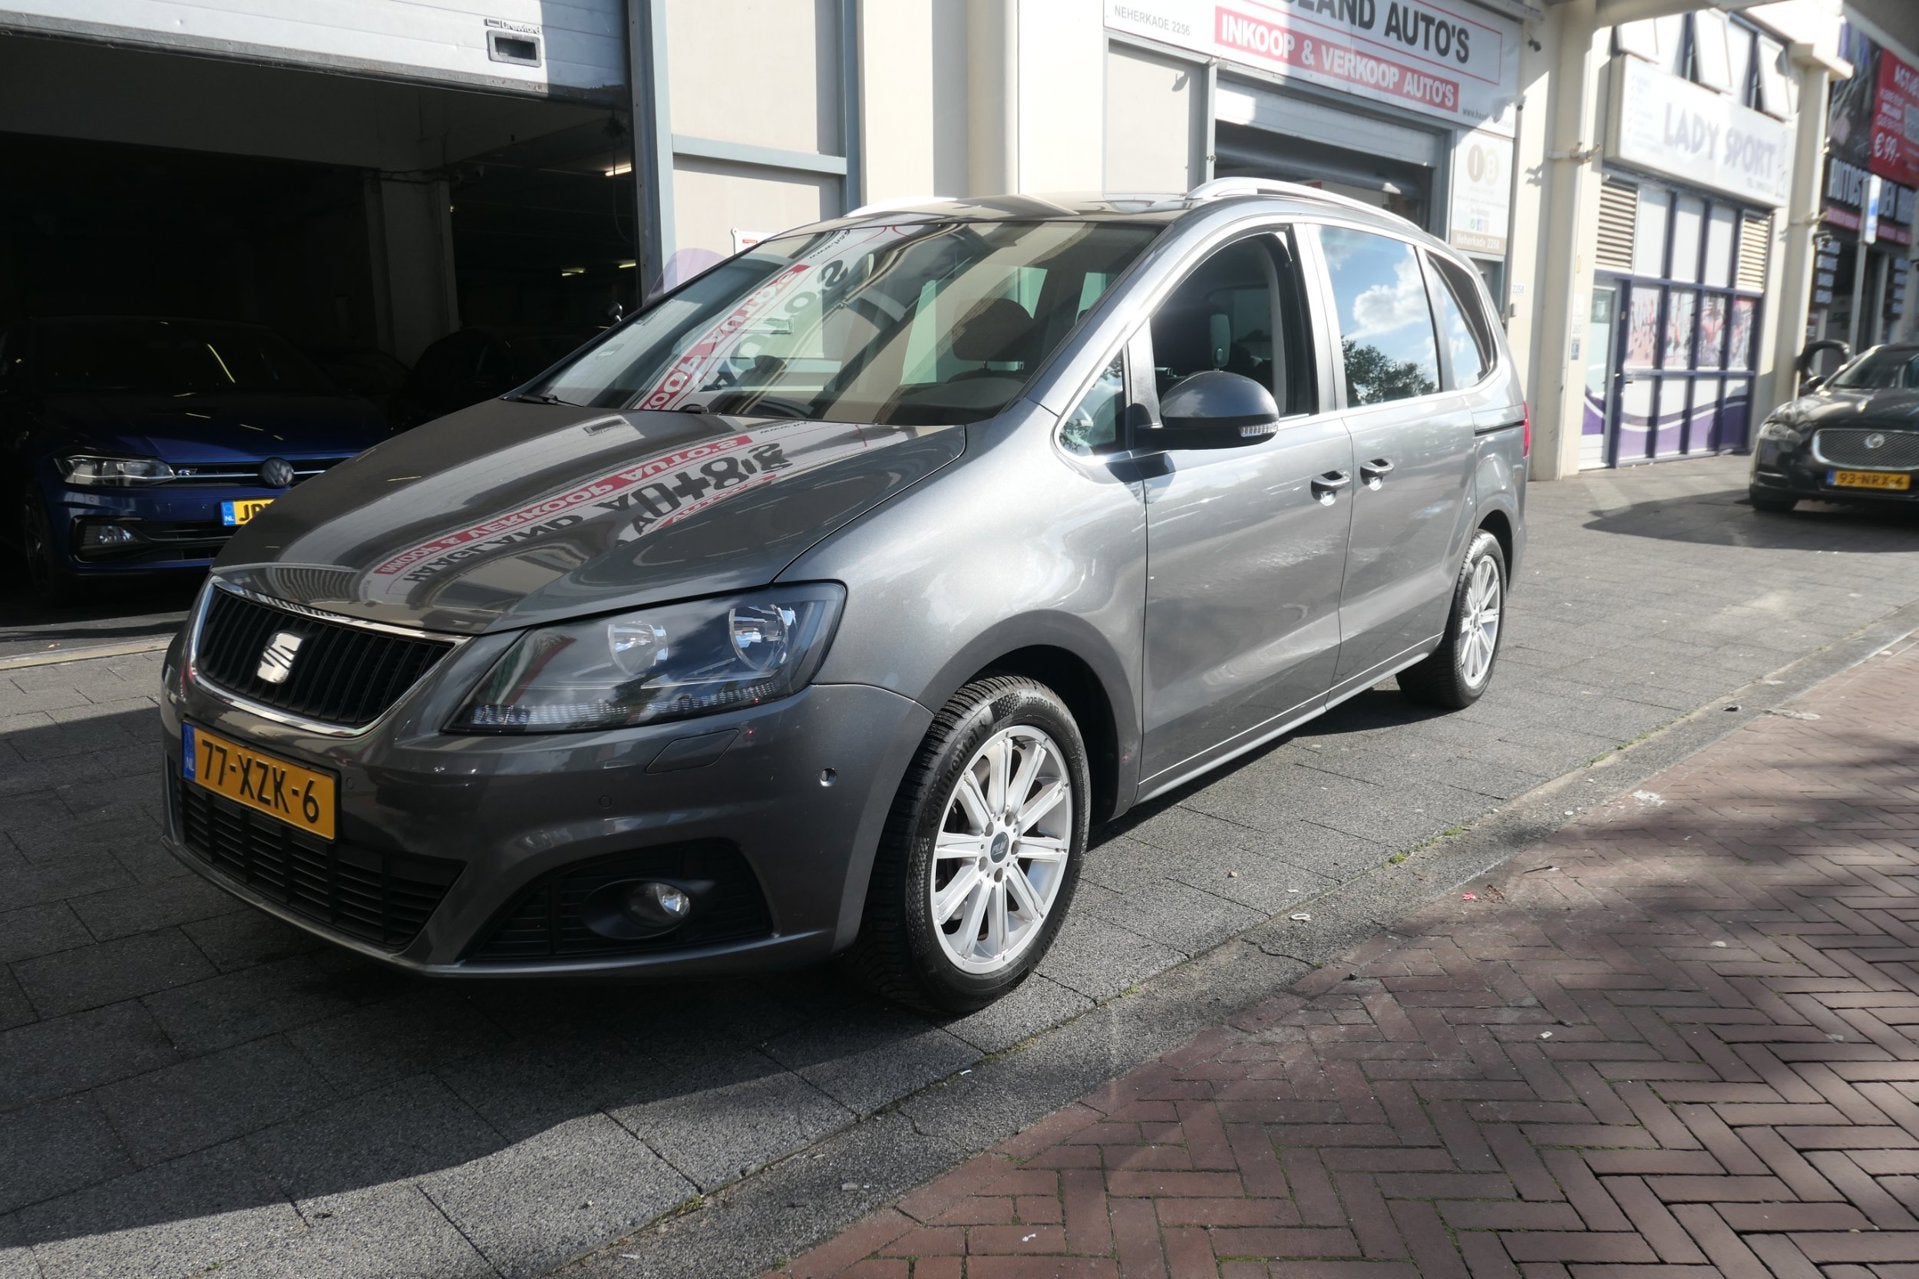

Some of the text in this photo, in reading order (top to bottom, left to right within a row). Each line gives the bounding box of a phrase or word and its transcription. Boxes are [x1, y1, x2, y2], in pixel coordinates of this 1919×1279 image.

[1114, 5, 1191, 36] NEHERKADE 2256
[1383, 6, 1470, 65] AUTO'S
[1221, 13, 1455, 107] INKOOP & VERKOOP AUTO'S
[1664, 102, 1720, 160] LADY
[1724, 126, 1776, 179] SPORT
[202, 739, 320, 824] 77-XZK-6
